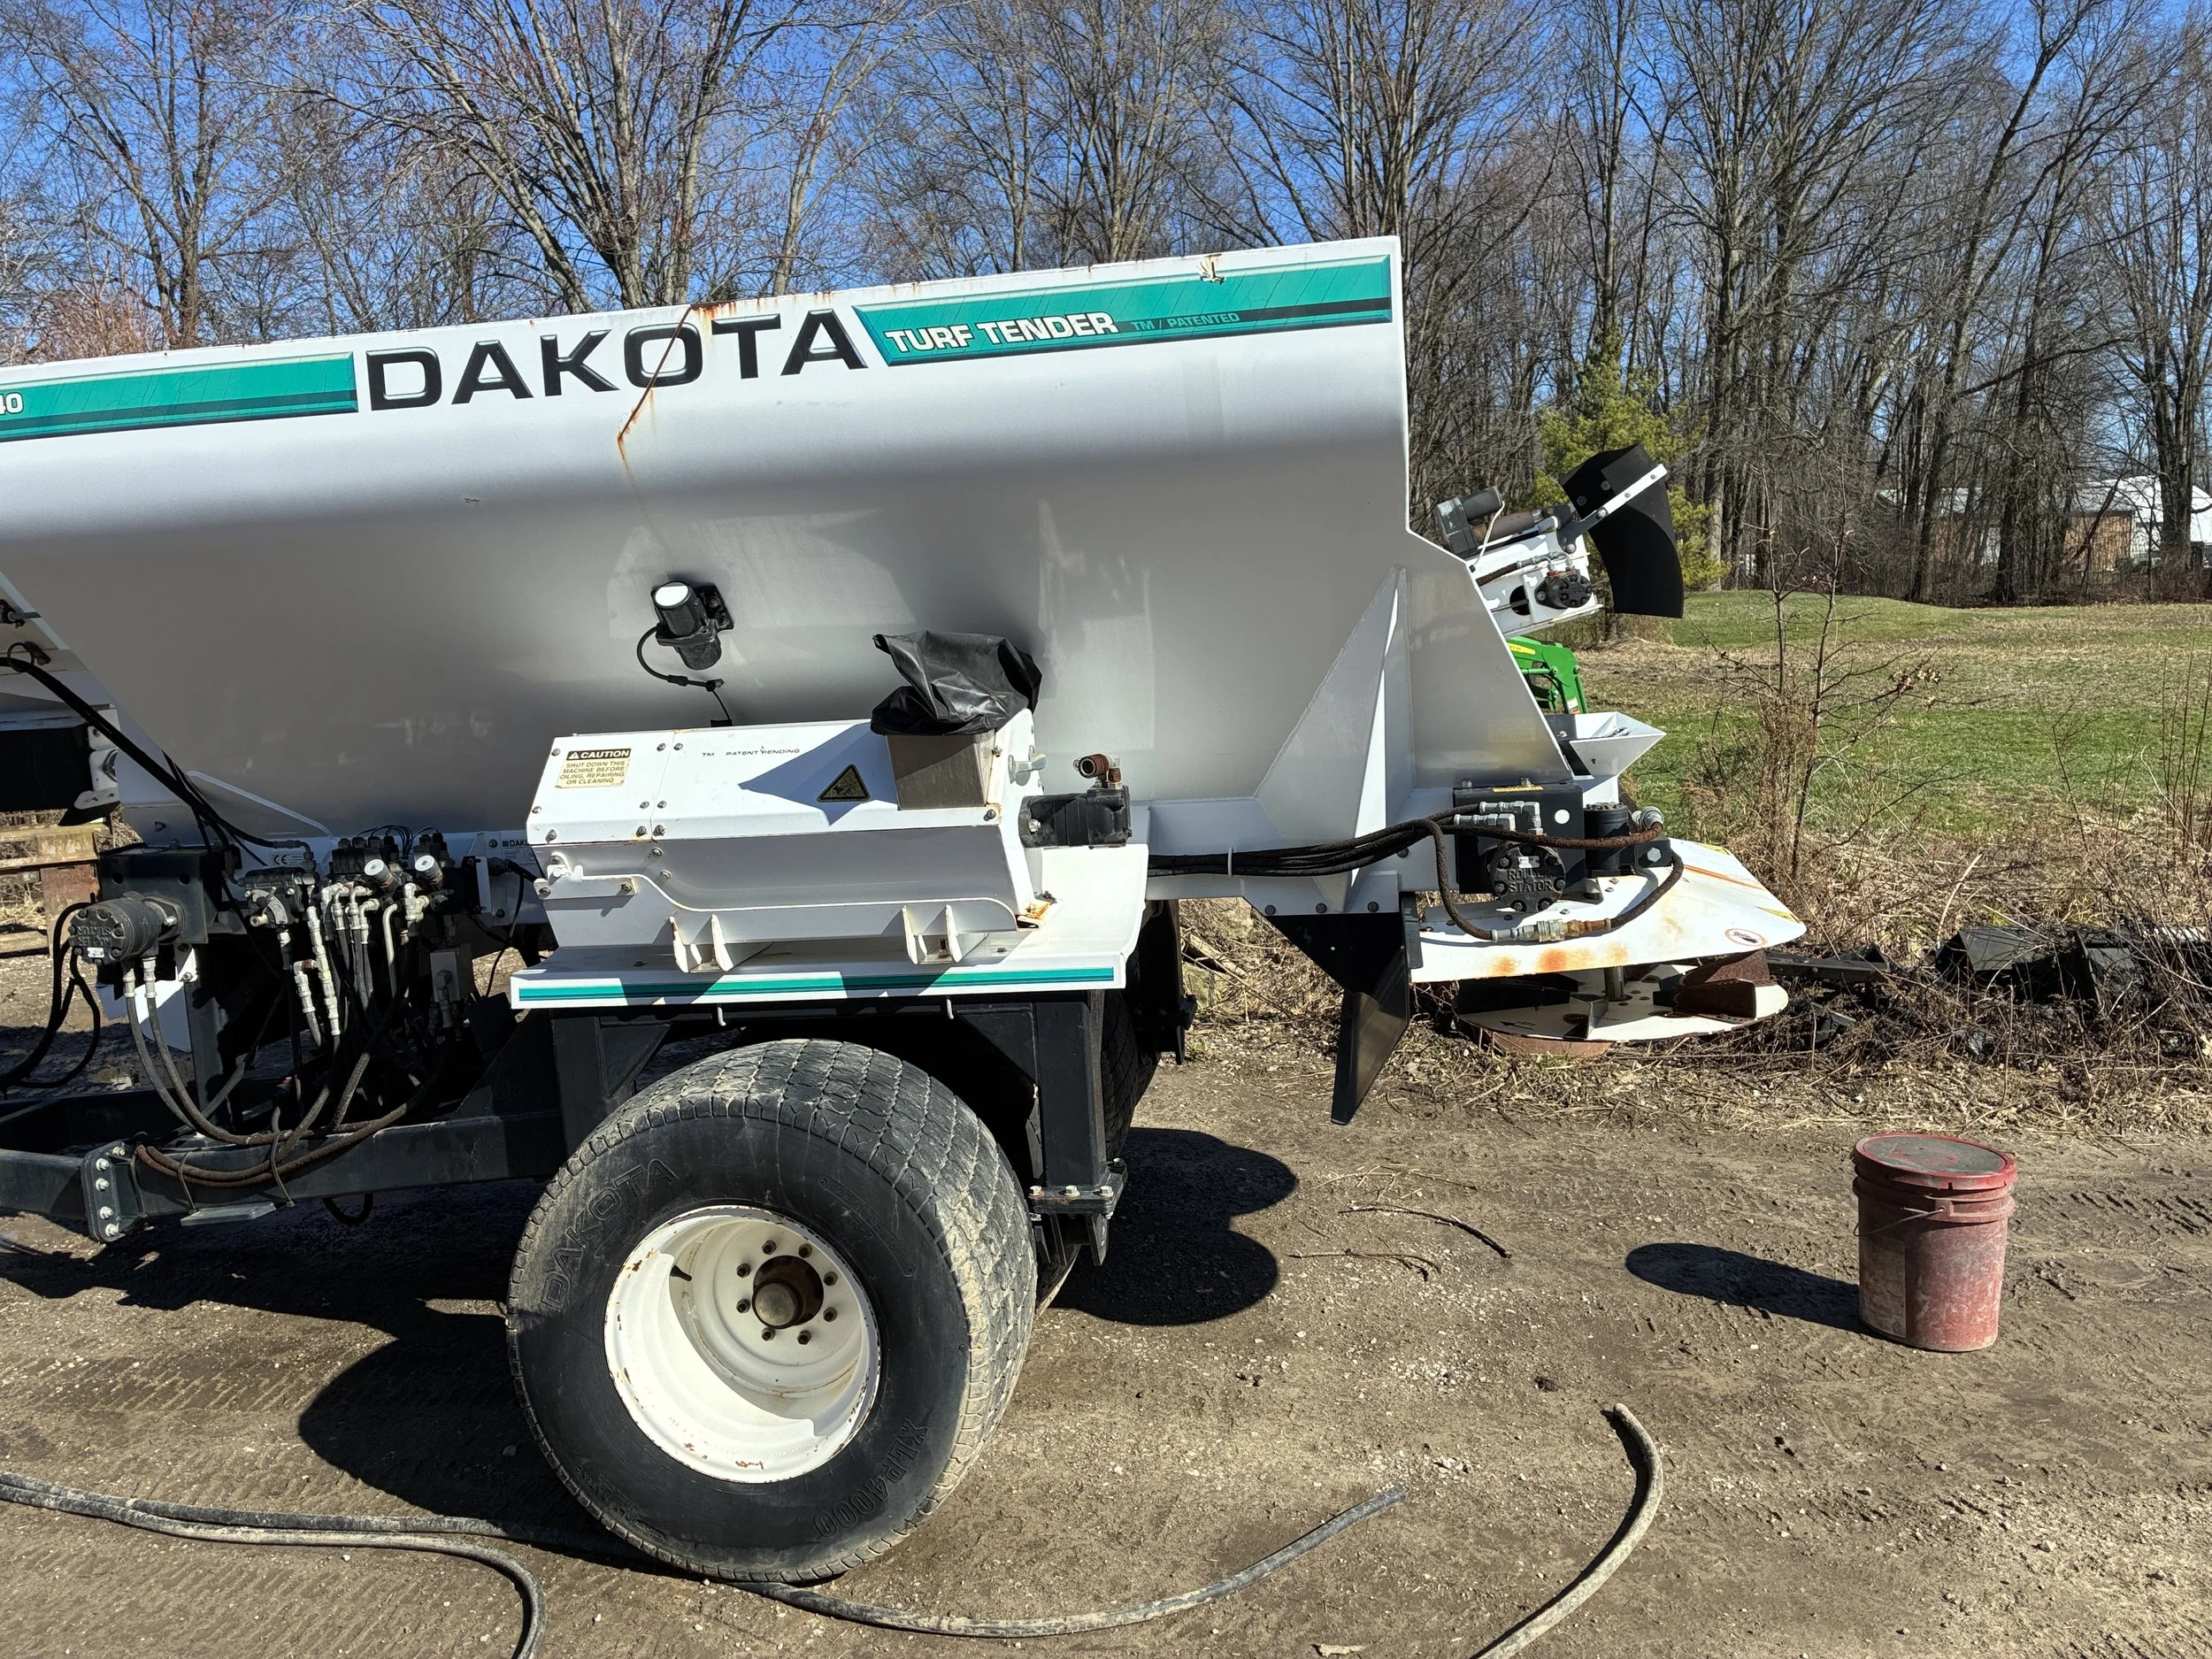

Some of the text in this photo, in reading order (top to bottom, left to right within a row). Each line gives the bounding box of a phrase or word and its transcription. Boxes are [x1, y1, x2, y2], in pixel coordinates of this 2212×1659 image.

[365, 308, 869, 411] DAKOTA
[885, 324, 973, 354] TURF
[975, 311, 1120, 344] TENDER
[1131, 320, 1155, 331] TM
[1167, 311, 1240, 327] PATENTED
[580, 749, 630, 759] CAUTION
[1508, 879, 1554, 893] STATOR
[540, 1158, 680, 1311] DAKOTA
[814, 1417, 929, 1539] XLP4000
